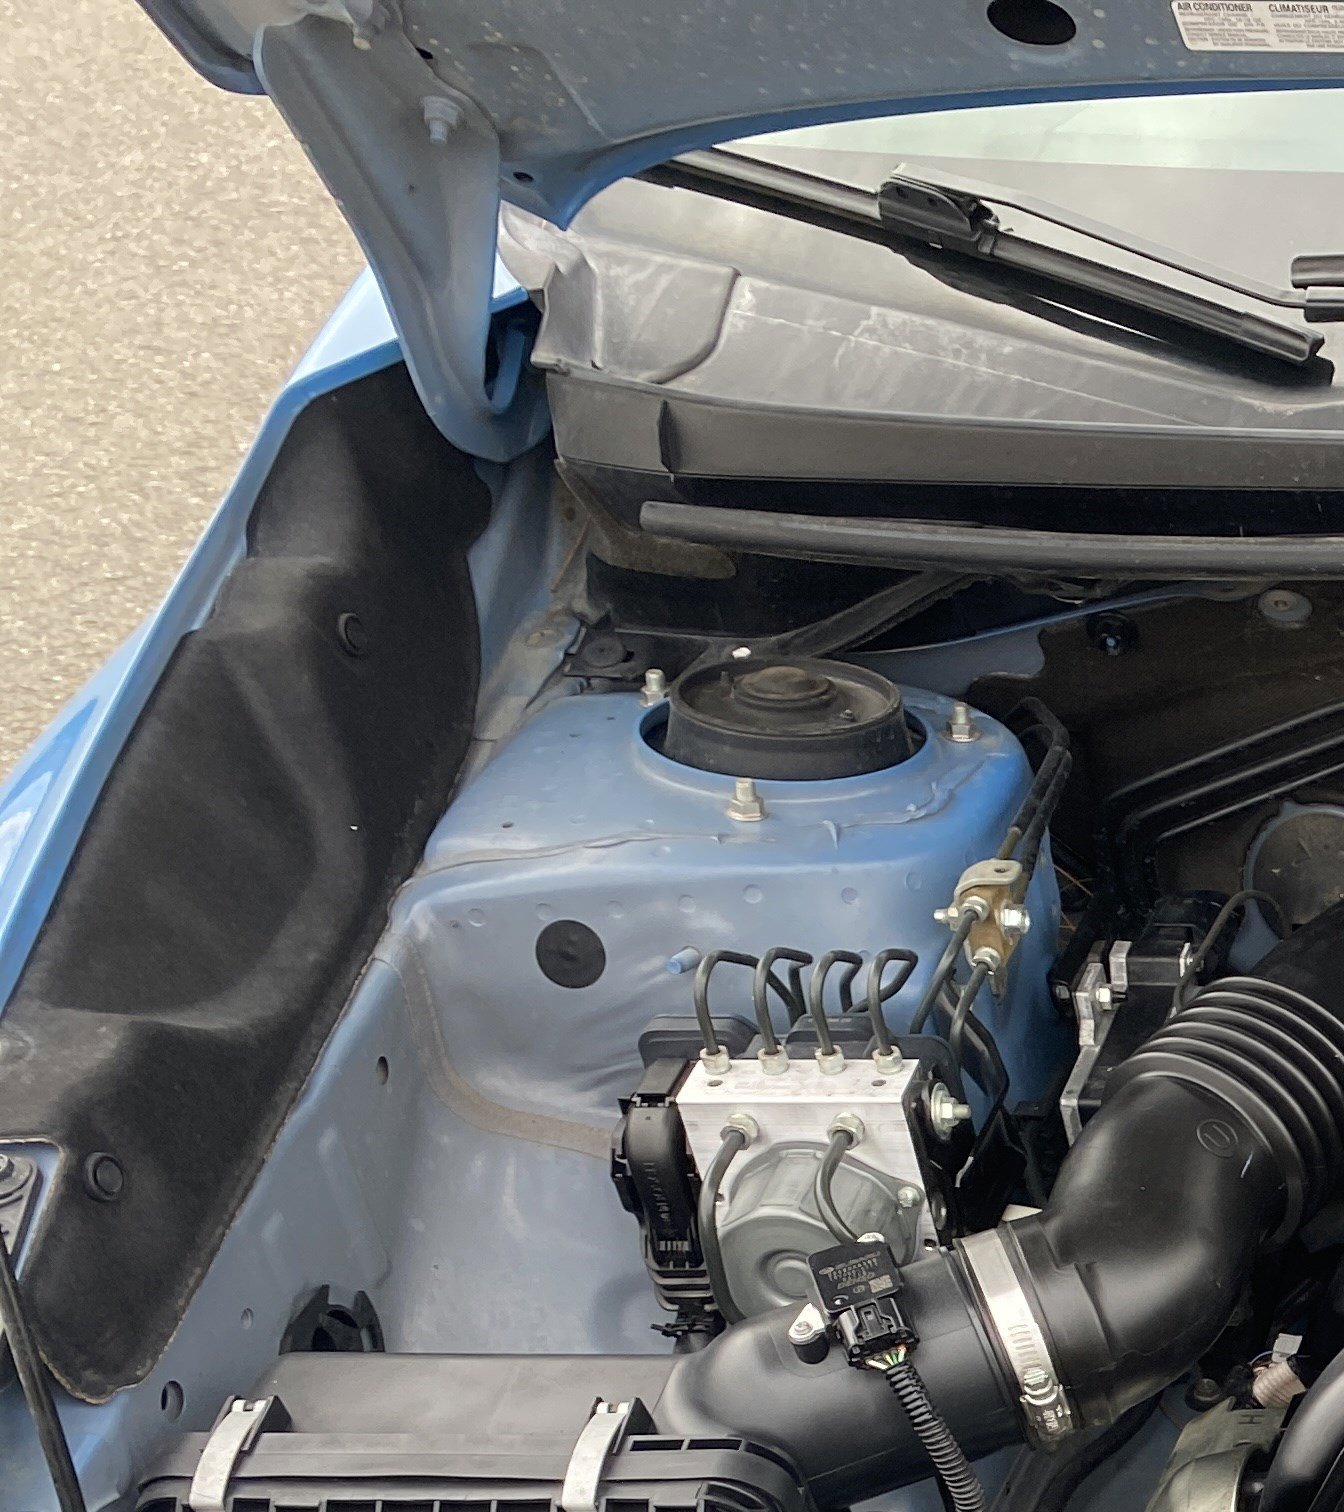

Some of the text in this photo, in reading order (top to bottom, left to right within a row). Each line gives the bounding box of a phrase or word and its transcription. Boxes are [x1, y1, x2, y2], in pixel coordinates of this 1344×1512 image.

[1177, 3, 1253, 13] AIR CONDITIONER
[1268, 4, 1329, 14] CLIMATISEUR
